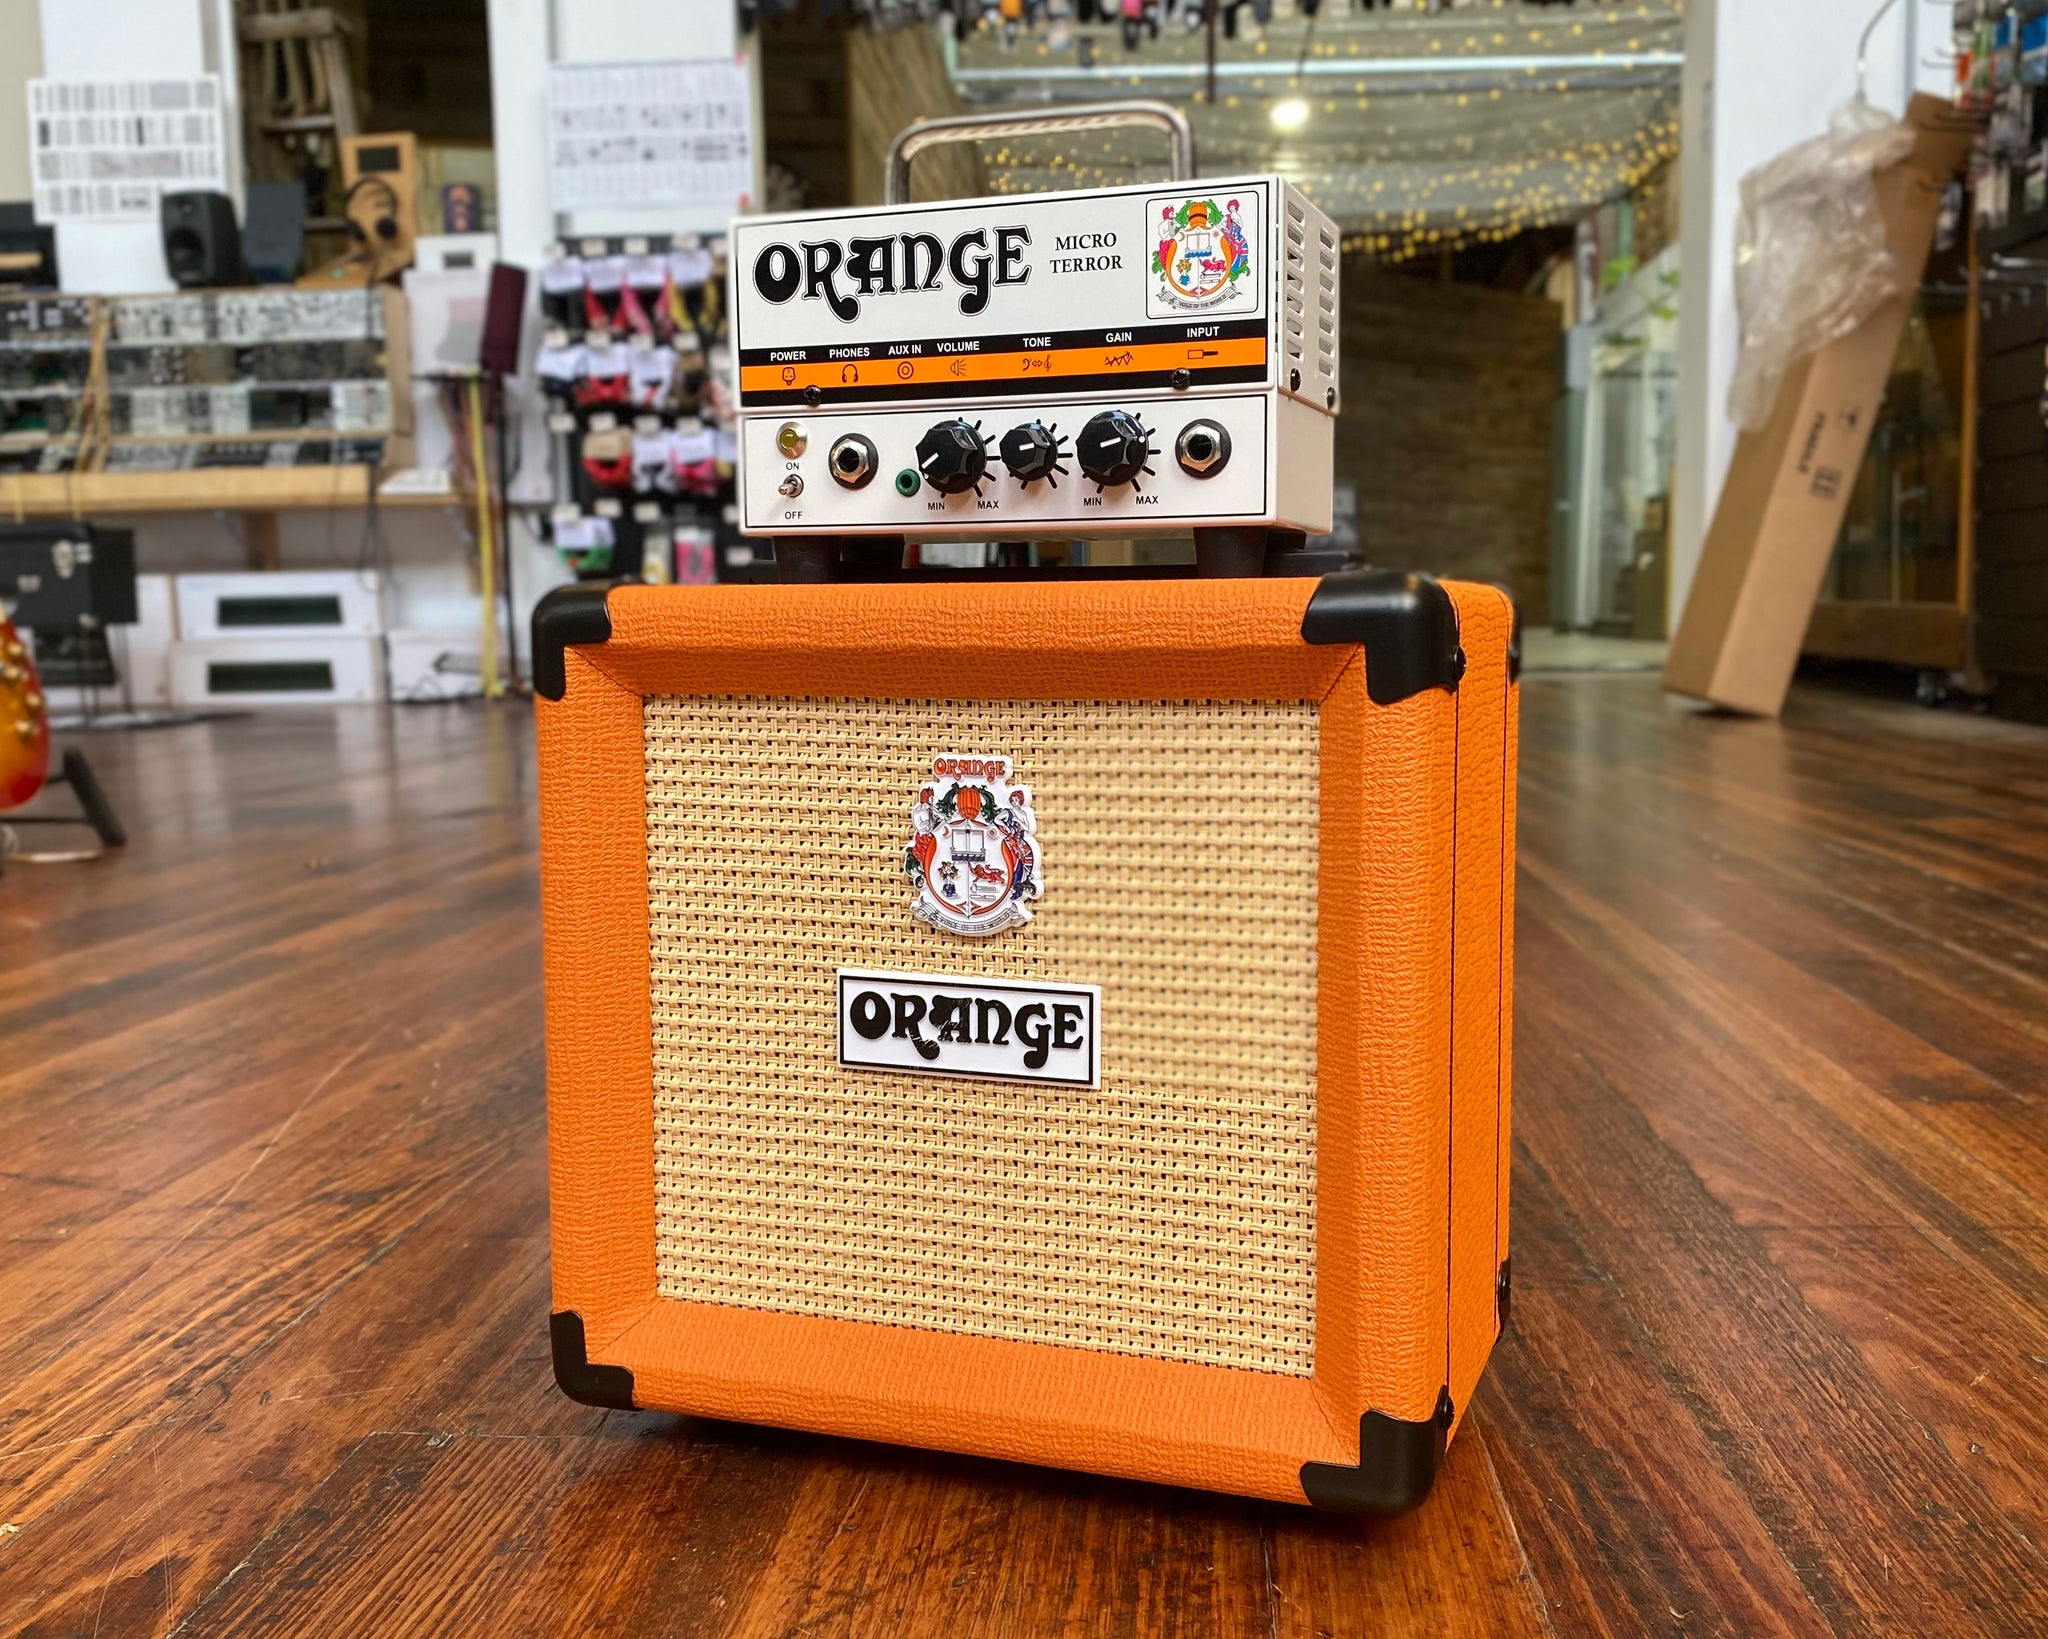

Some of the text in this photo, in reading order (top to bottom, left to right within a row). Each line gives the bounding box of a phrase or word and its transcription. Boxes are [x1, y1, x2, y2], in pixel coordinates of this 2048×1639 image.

[1054, 232, 1117, 252] MICRO
[1049, 254, 1123, 274] TERROR
[753, 225, 1032, 323] ORANGE
[1105, 332, 1133, 343] GAIN
[1186, 326, 1221, 338] INPUT
[937, 341, 980, 353] VOLUME
[1022, 336, 1052, 348] TONE
[770, 350, 807, 362] POWER
[829, 347, 870, 359] PHONES
[888, 345, 922, 356] AUX IN
[785, 462, 800, 471] ON
[977, 500, 1000, 510] MAX
[1083, 497, 1102, 507] MIN
[1135, 495, 1159, 505] MAX
[927, 502, 946, 511] MIN
[784, 511, 803, 520] OFF
[933, 757, 1007, 782] ORANGE
[850, 990, 1084, 1070] ORANGE
